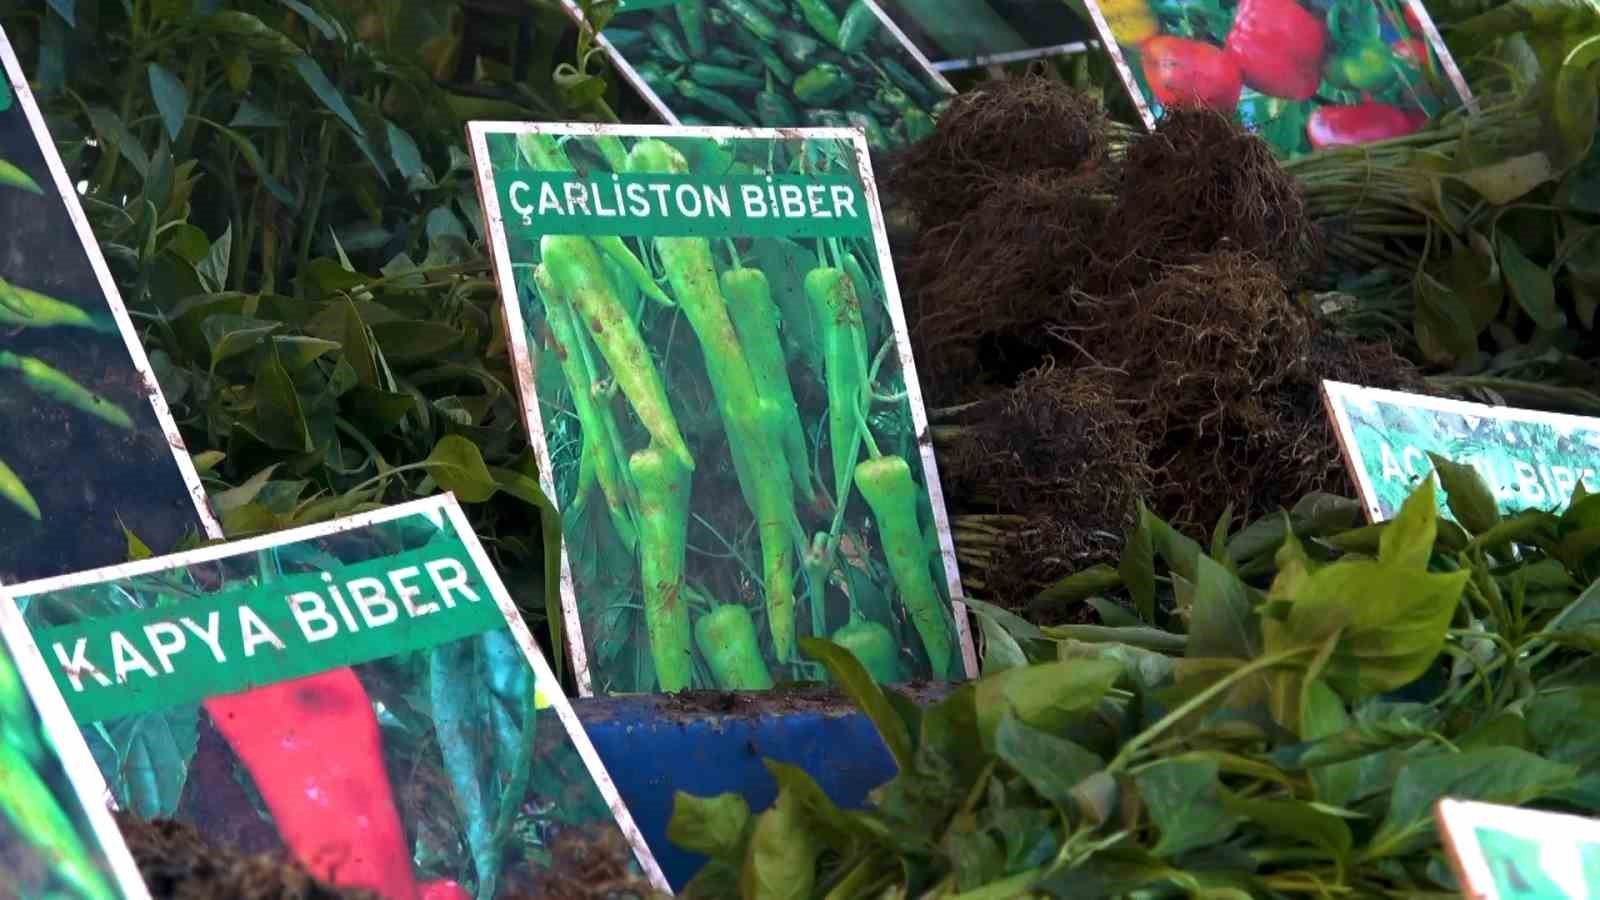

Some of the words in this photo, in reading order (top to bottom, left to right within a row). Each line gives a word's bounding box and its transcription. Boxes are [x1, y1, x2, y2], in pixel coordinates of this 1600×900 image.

[508, 174, 728, 225] ÇARLİSTON
[741, 176, 858, 218] BİBER
[52, 605, 287, 692] KAPYA
[286, 557, 481, 643] BİBER
